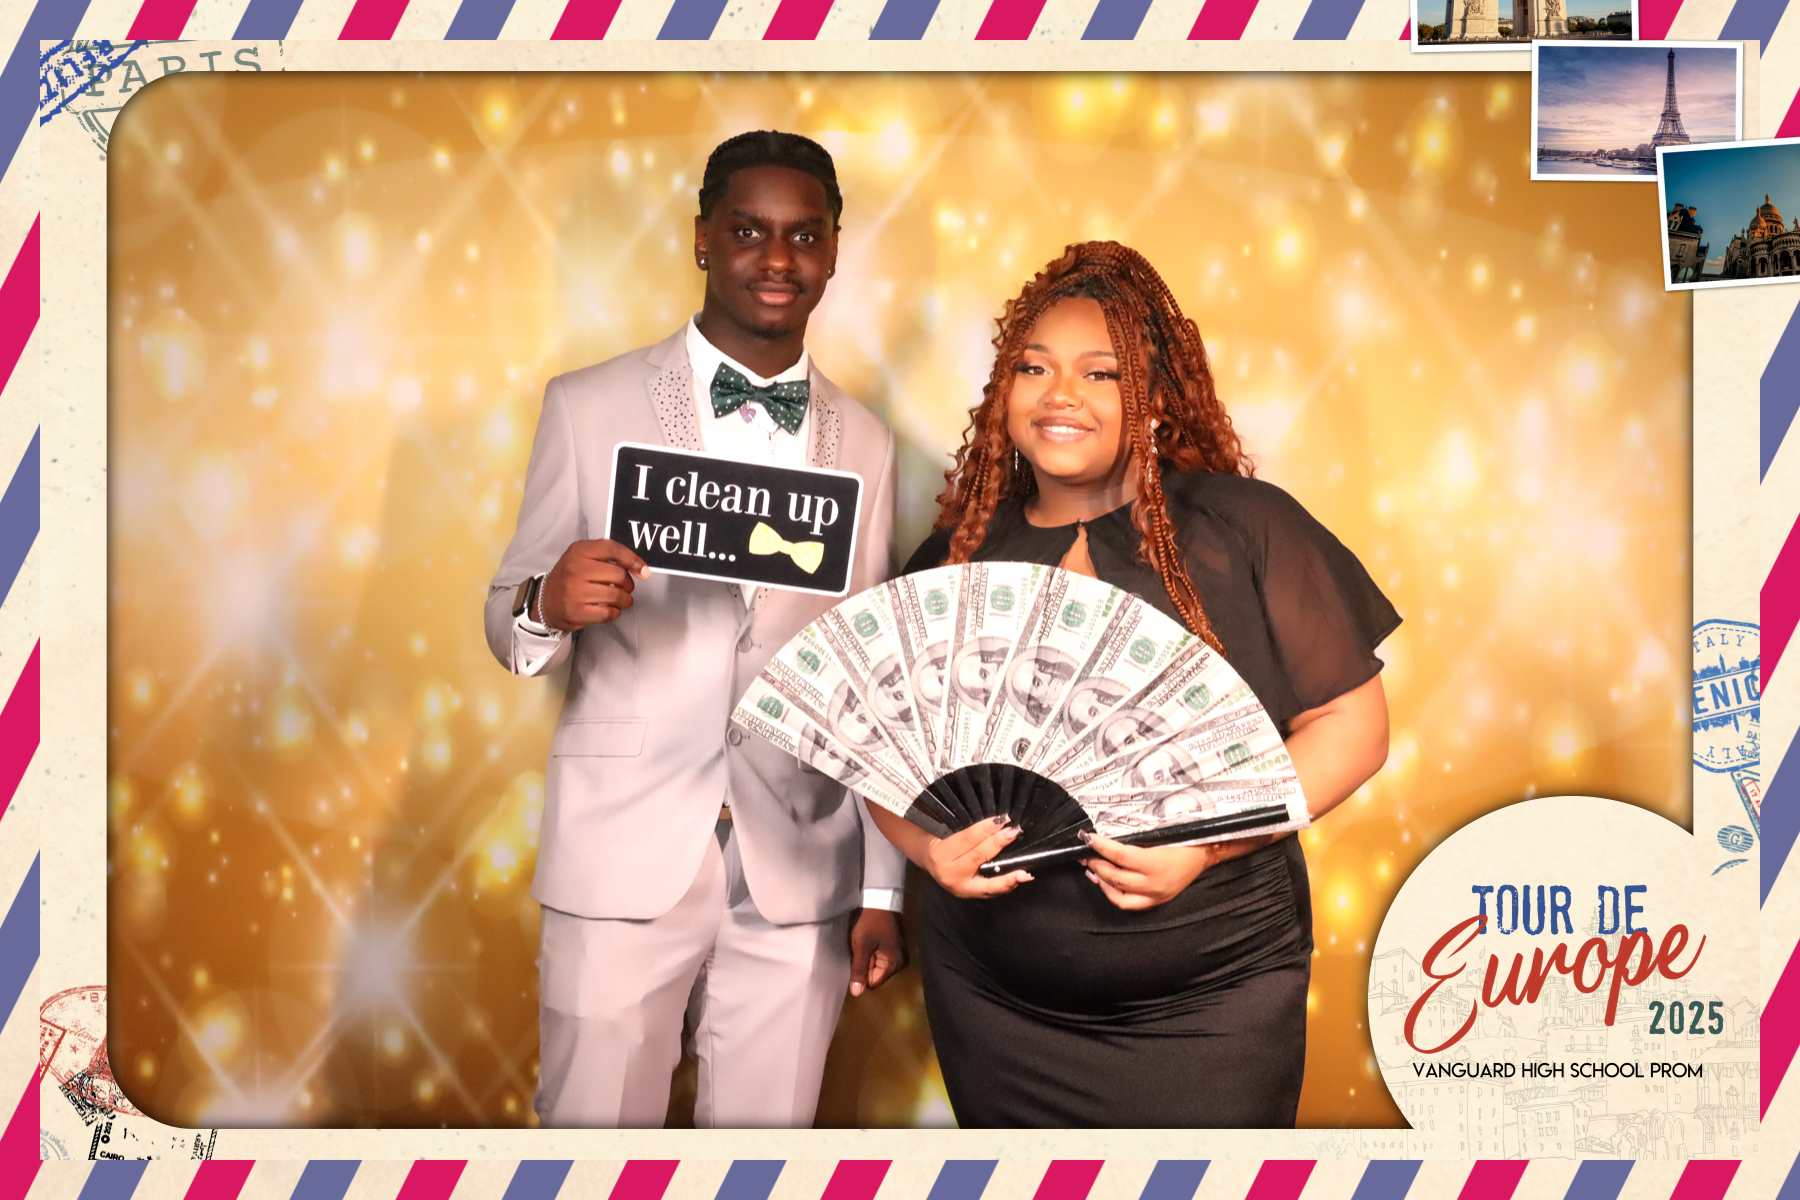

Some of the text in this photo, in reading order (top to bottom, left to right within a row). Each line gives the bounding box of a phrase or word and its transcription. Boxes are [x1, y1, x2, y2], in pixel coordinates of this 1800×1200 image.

[632, 464, 839, 536] I clean up
[628, 519, 736, 562] well...
